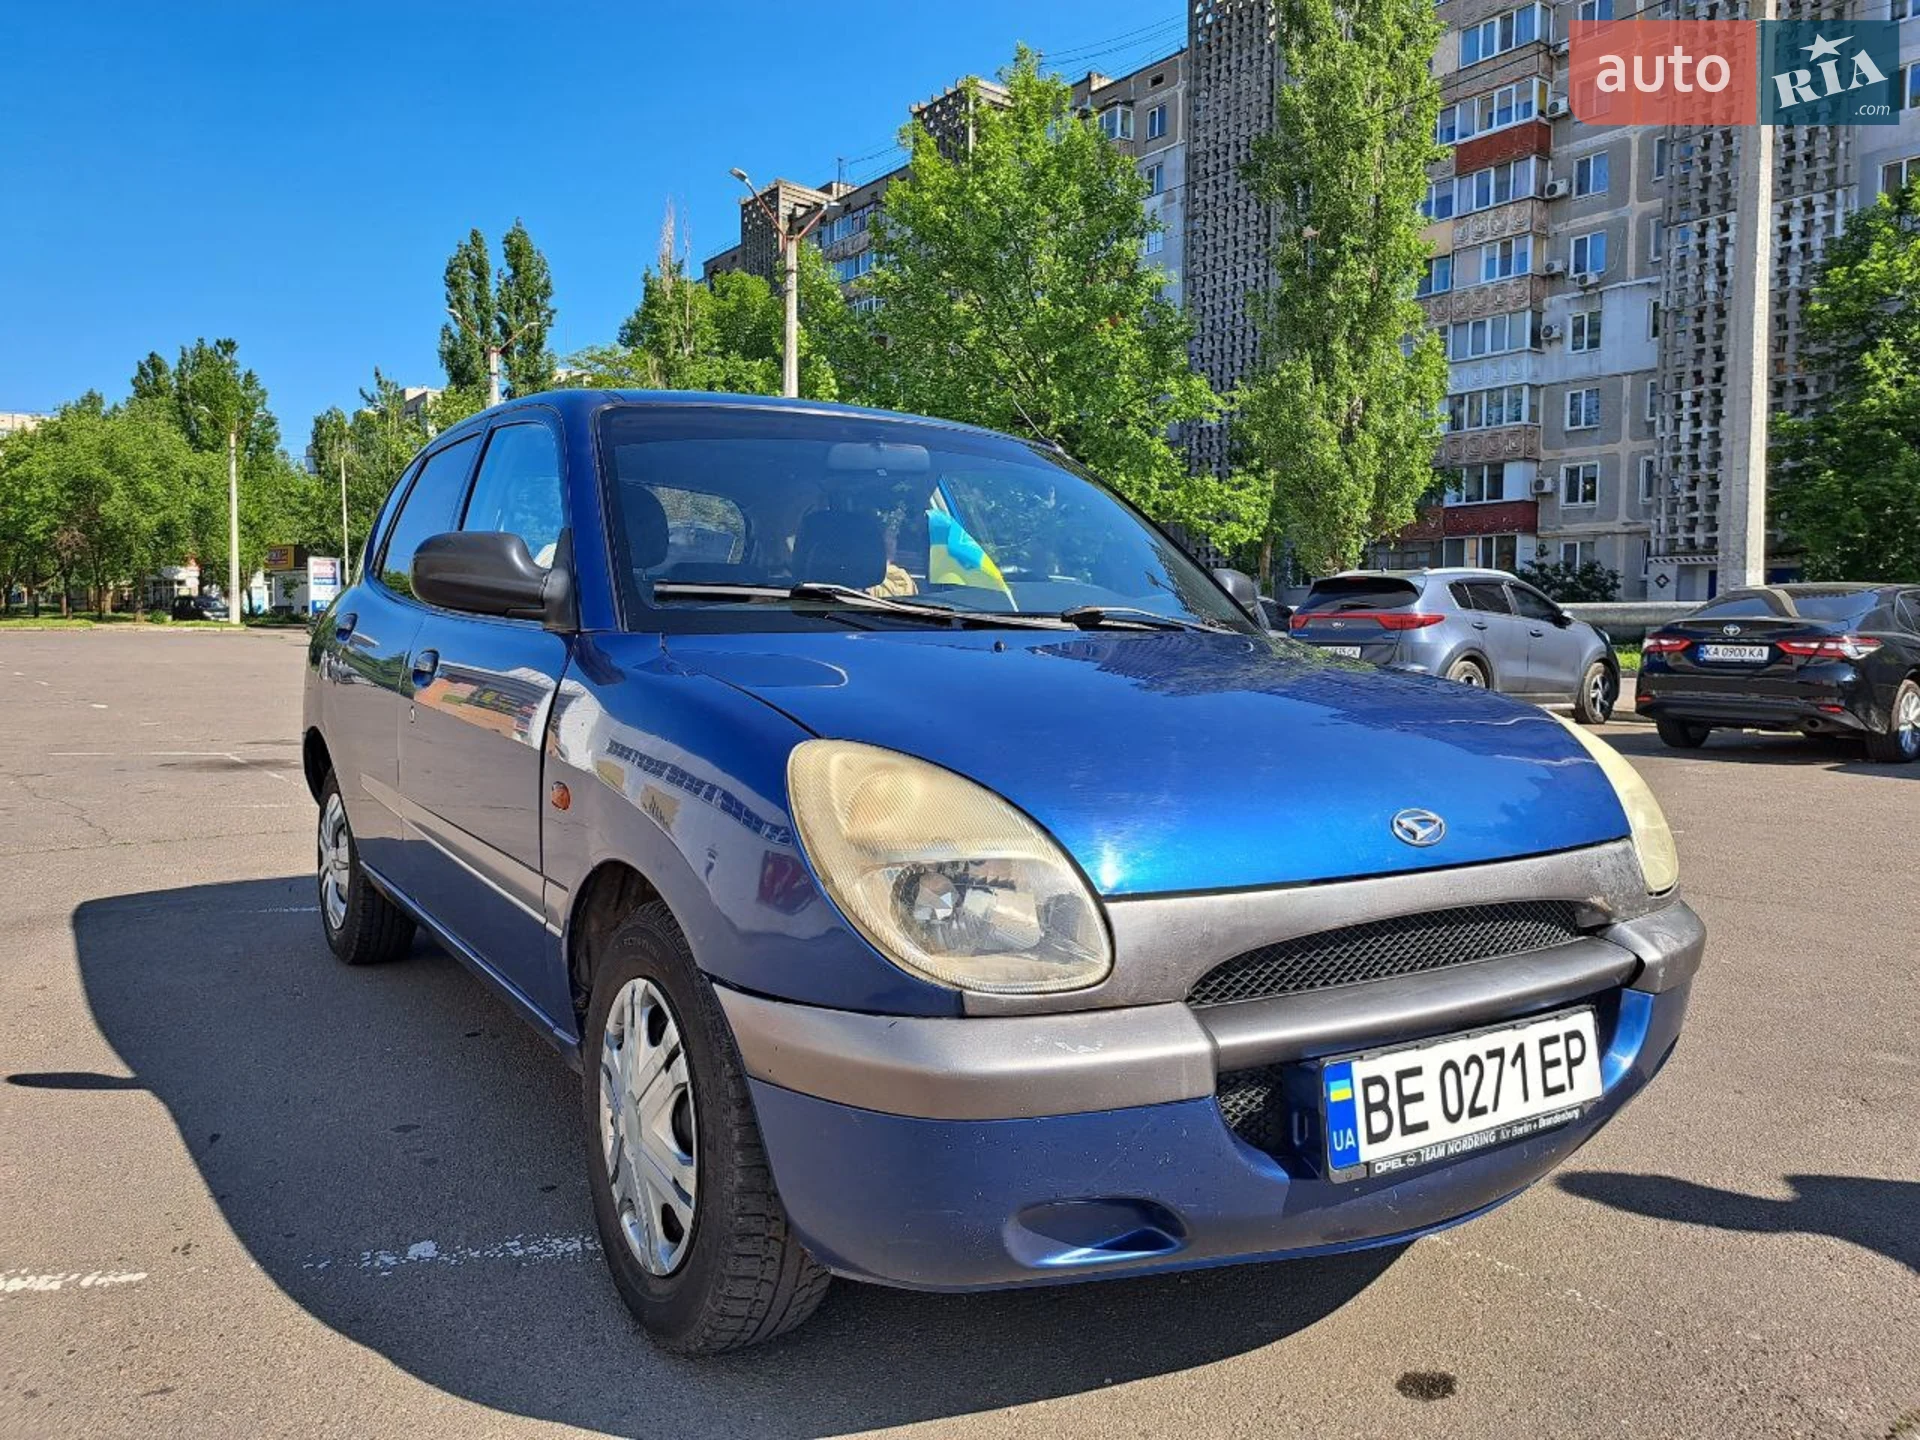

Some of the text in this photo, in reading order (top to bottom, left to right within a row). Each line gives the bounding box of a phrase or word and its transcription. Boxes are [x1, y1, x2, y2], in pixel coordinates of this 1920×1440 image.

[1705, 647, 1764, 657] KA 0900 KA
[1361, 1029, 1587, 1145] BE 0271 EP
[1333, 1128, 1356, 1151] UA
[1375, 1157, 1405, 1174] OPEL
[1420, 1143, 1445, 1162] TEAM
[1447, 1130, 1496, 1155] NORDRING
[1511, 1122, 1532, 1136] Berlin
